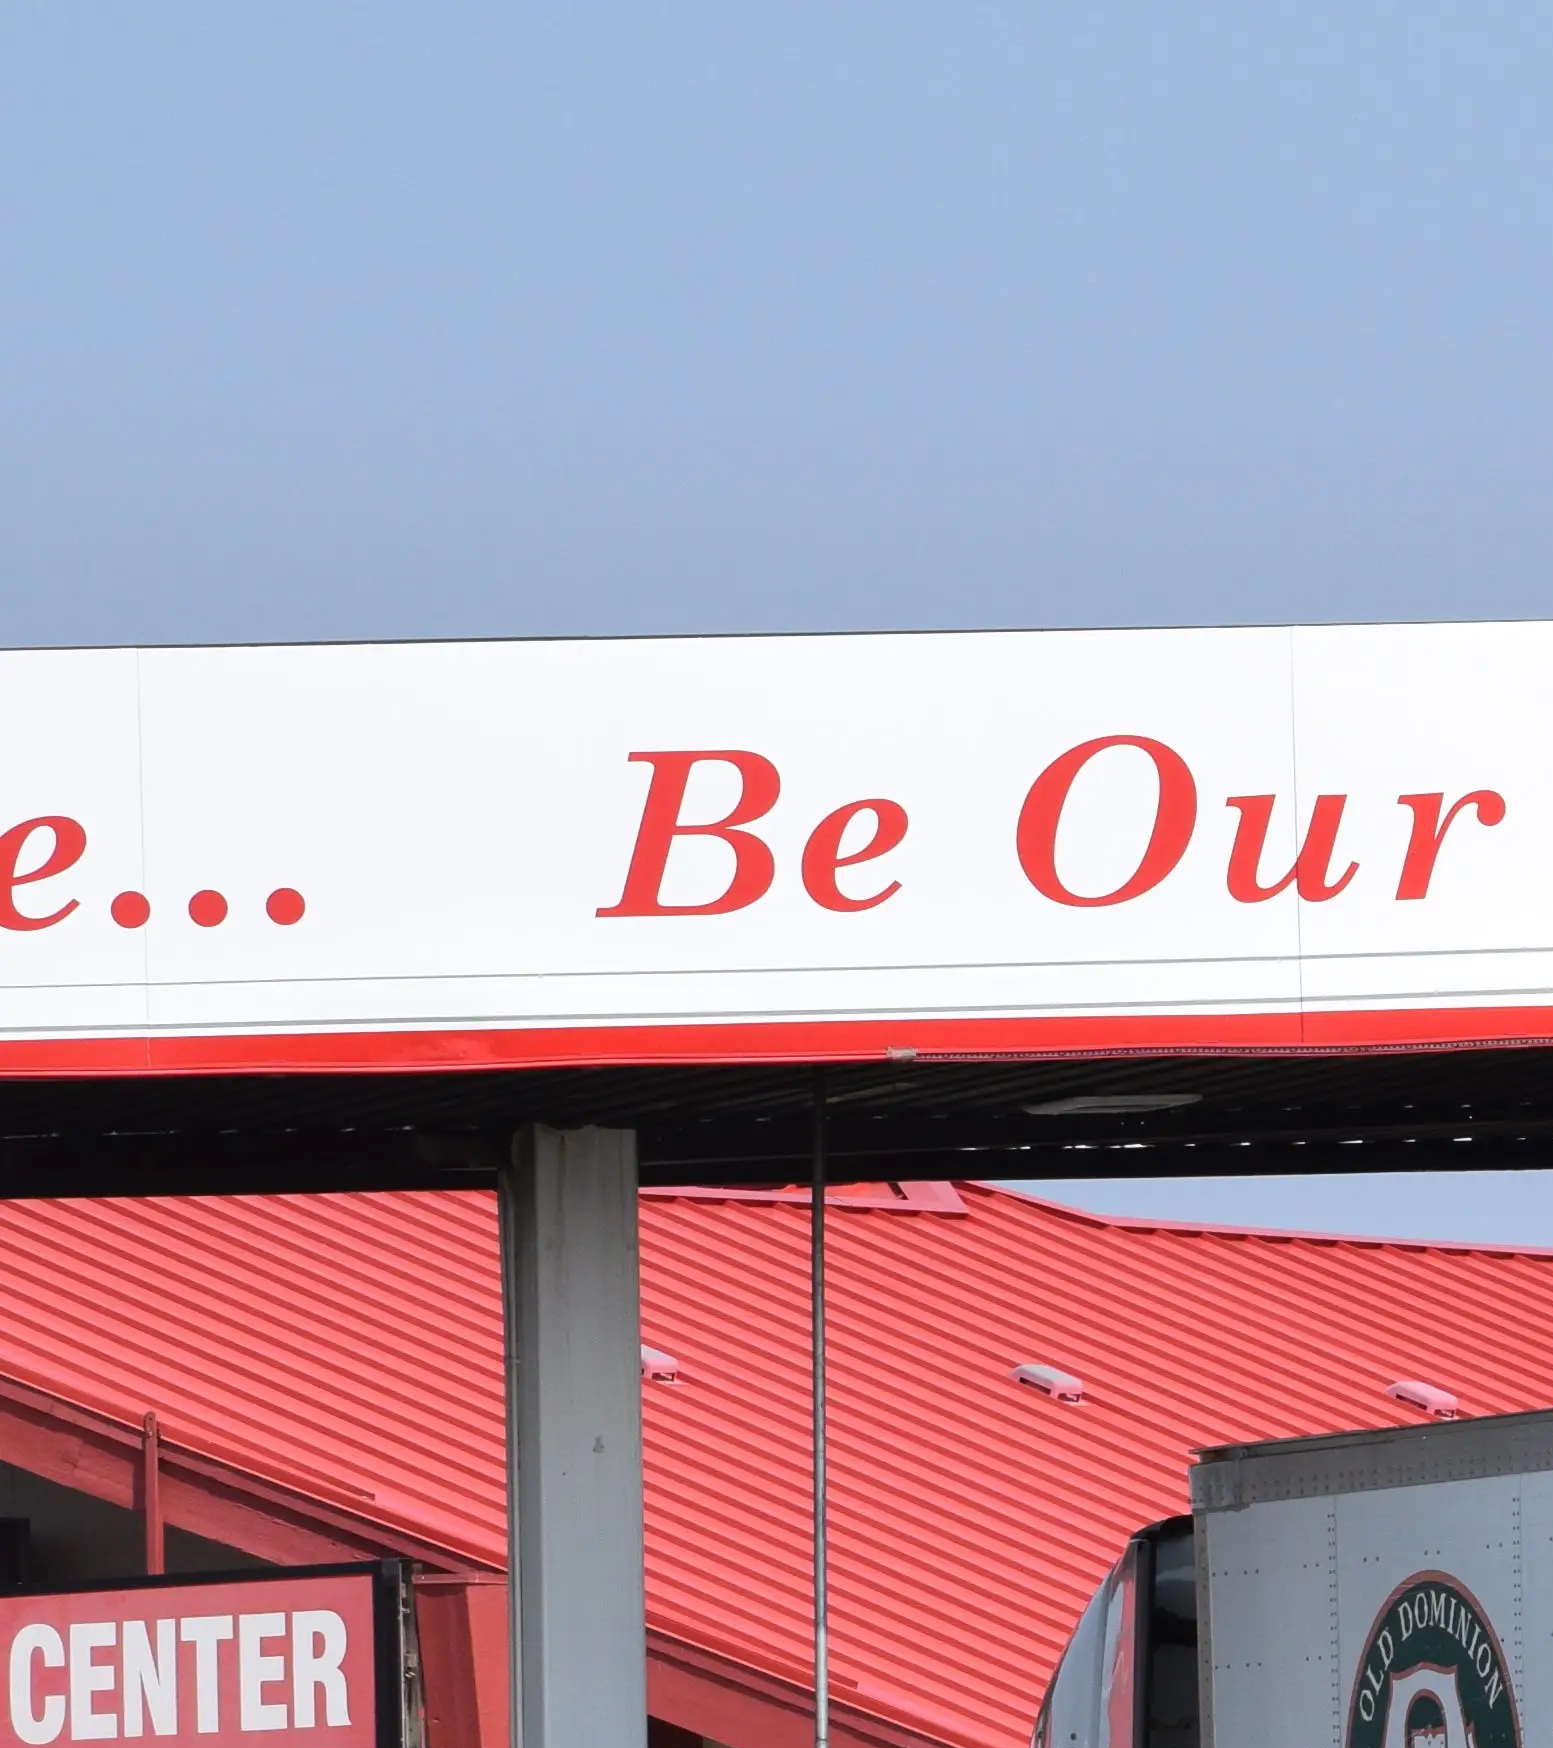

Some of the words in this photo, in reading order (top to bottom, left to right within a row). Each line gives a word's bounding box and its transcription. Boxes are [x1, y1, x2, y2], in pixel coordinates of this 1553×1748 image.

[594, 749, 909, 918] Be
[1015, 734, 1507, 909] Our
[9, 1608, 352, 1746] CENTER
[1356, 1626, 1396, 1723] OLD
[1397, 1588, 1505, 1710] DOMINION
